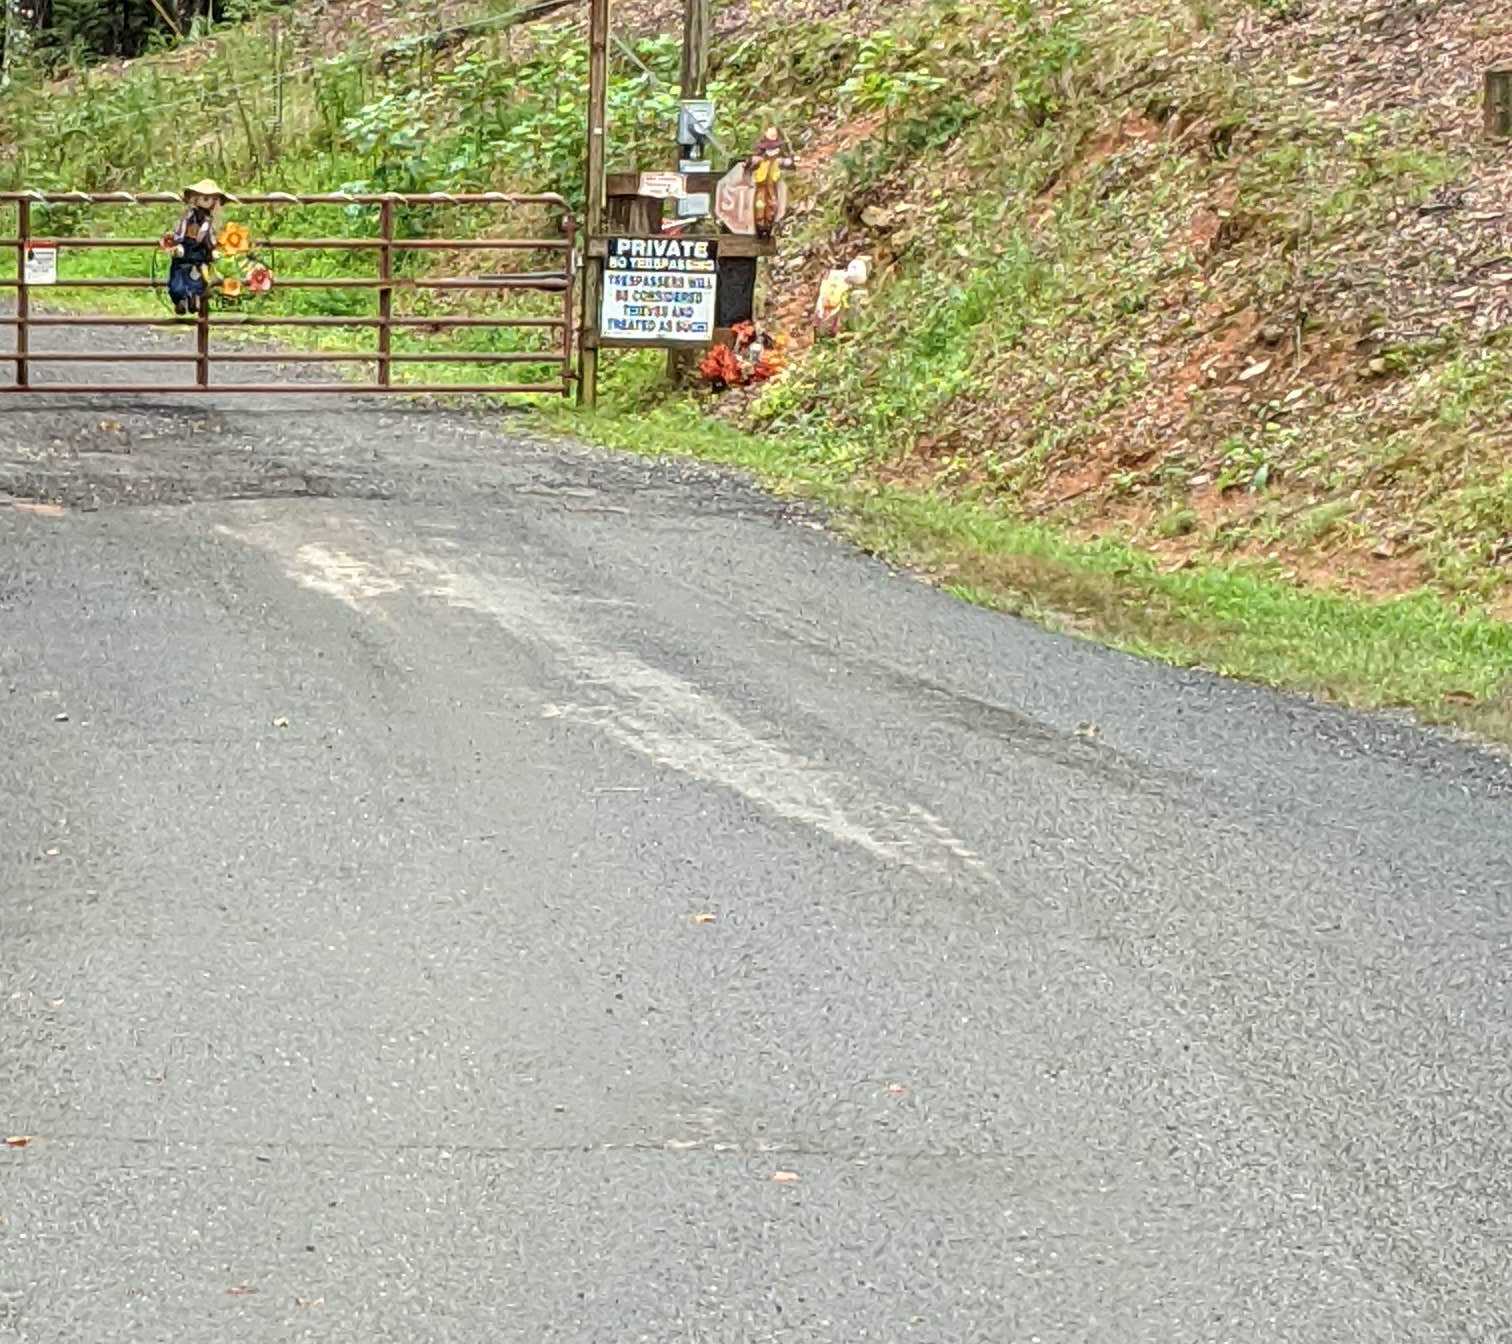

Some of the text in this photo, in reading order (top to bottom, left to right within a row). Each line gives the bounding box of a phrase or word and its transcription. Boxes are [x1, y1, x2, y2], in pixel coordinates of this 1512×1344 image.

[616, 238, 709, 258] PRIVATE
[609, 256, 627, 268] NO
[608, 274, 712, 289] TRESPASSERS WILL
[632, 290, 702, 304] CONSIDERED
[672, 306, 694, 318] AND
[608, 318, 656, 332] TREATED
[658, 320, 672, 332] AS
